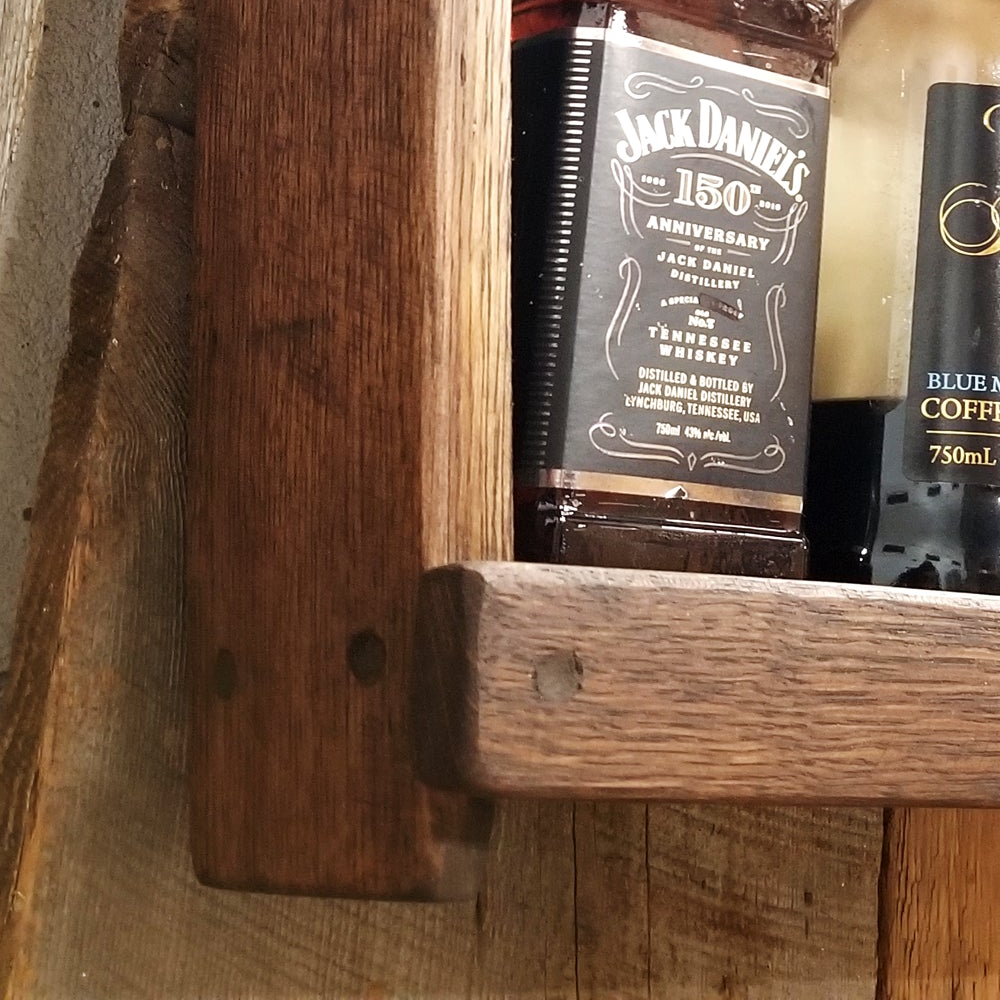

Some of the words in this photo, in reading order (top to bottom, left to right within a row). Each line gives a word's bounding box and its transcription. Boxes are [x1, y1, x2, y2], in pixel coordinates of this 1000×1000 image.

[614, 108, 696, 163] JACK
[699, 99, 811, 203] DANIEL'S
[646, 215, 771, 251] ANNIVERSARY
[694, 244, 705, 253] OF
[707, 246, 723, 256] THE
[657, 251, 697, 268] JACK
[703, 259, 755, 278] DANIEL
[670, 268, 740, 289] DISTILLERY
[668, 296, 699, 306] SPECIA
[648, 326, 752, 353] TENNESSEE
[659, 343, 739, 366] WHISKEY
[638, 366, 688, 385] DISTILLED
[689, 374, 697, 386] &
[699, 375, 740, 392] BOTTLED
[741, 381, 754, 394] BY
[927, 372, 987, 392] BLUE
[638, 382, 662, 396] JACK
[664, 385, 698, 401] DANIEL
[700, 390, 752, 408] DISTILLERY
[625, 396, 686, 415] LYNCHBURG,
[687, 402, 742, 422] TENNESSEE,
[743, 412, 761, 424] USA
[929, 445, 997, 466] 750mL
